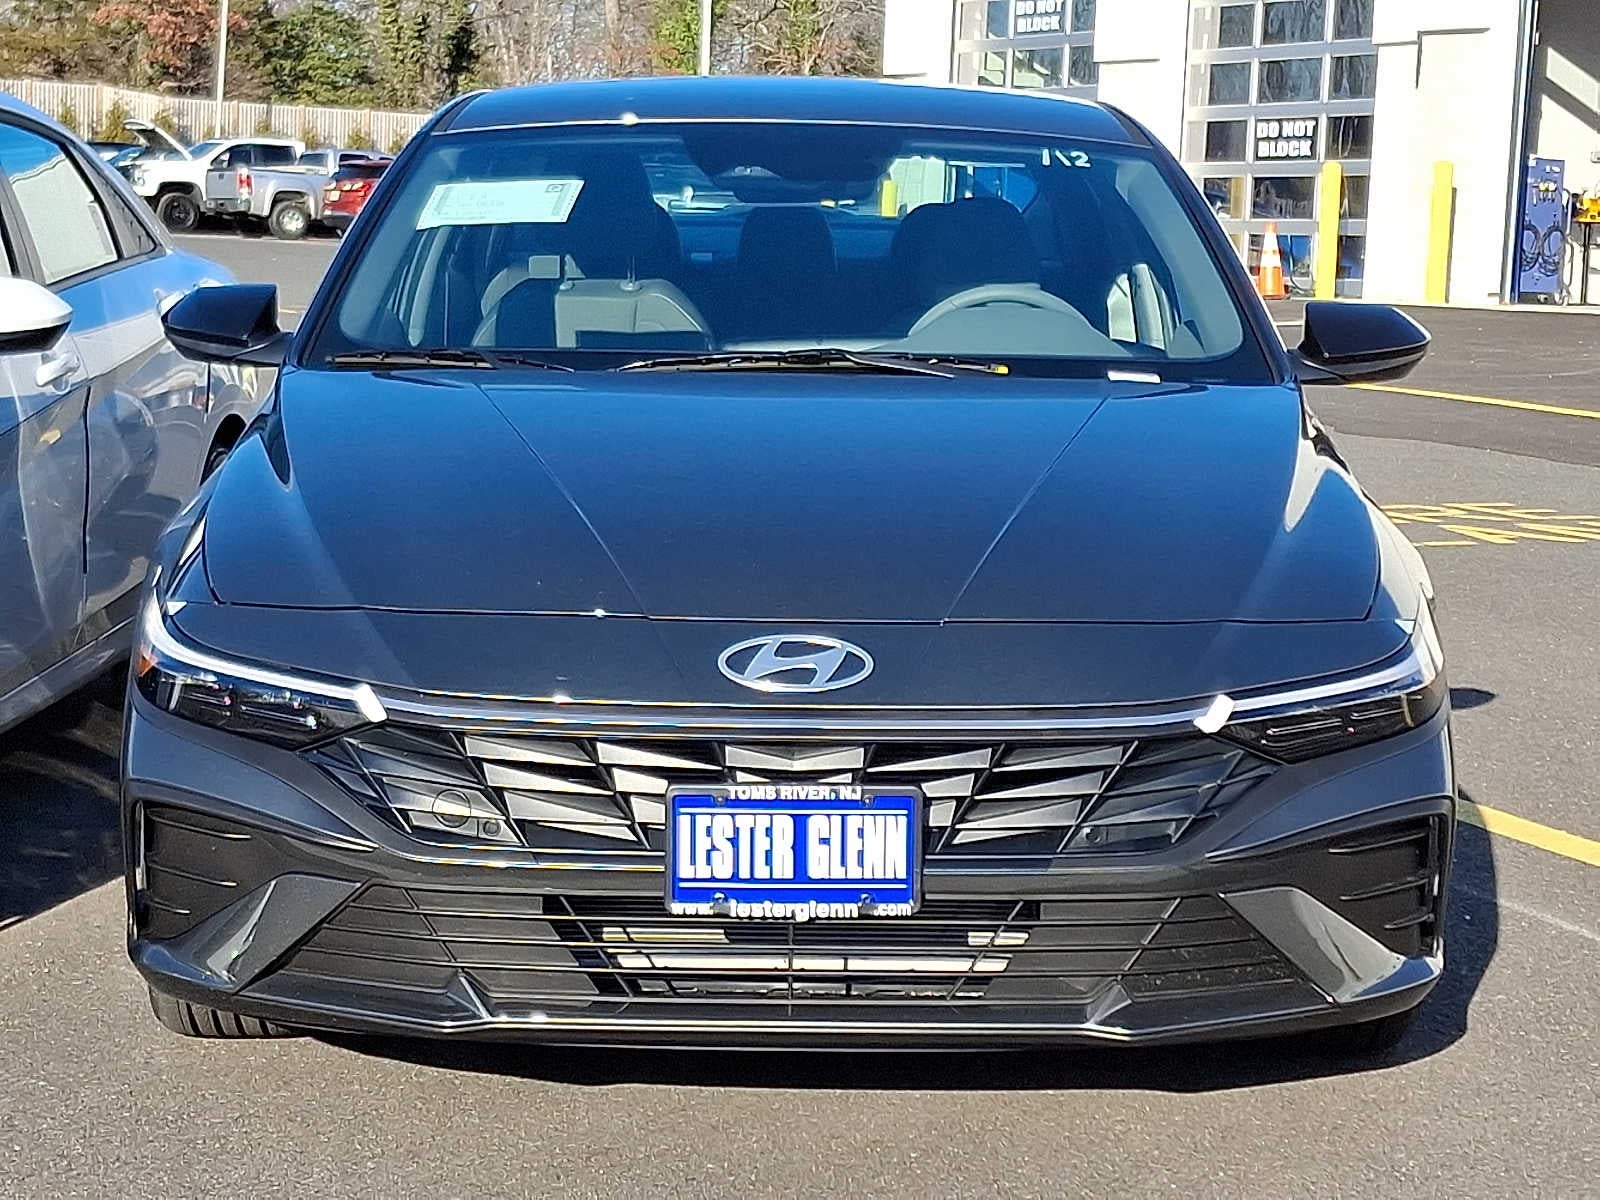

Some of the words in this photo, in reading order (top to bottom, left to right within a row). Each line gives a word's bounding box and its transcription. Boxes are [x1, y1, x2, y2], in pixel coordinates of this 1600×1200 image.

[1016, 0, 1035, 15] DO
[1036, 0, 1064, 14] NOT
[1017, 16, 1061, 32] BLOCK
[1257, 121, 1280, 138] DO
[1282, 120, 1316, 137] NOT
[1258, 140, 1312, 157] BLOCK
[729, 785, 777, 800] TOMS
[839, 785, 861, 800] NJ
[677, 814, 794, 879] LESTER
[807, 814, 908, 879] GLENN
